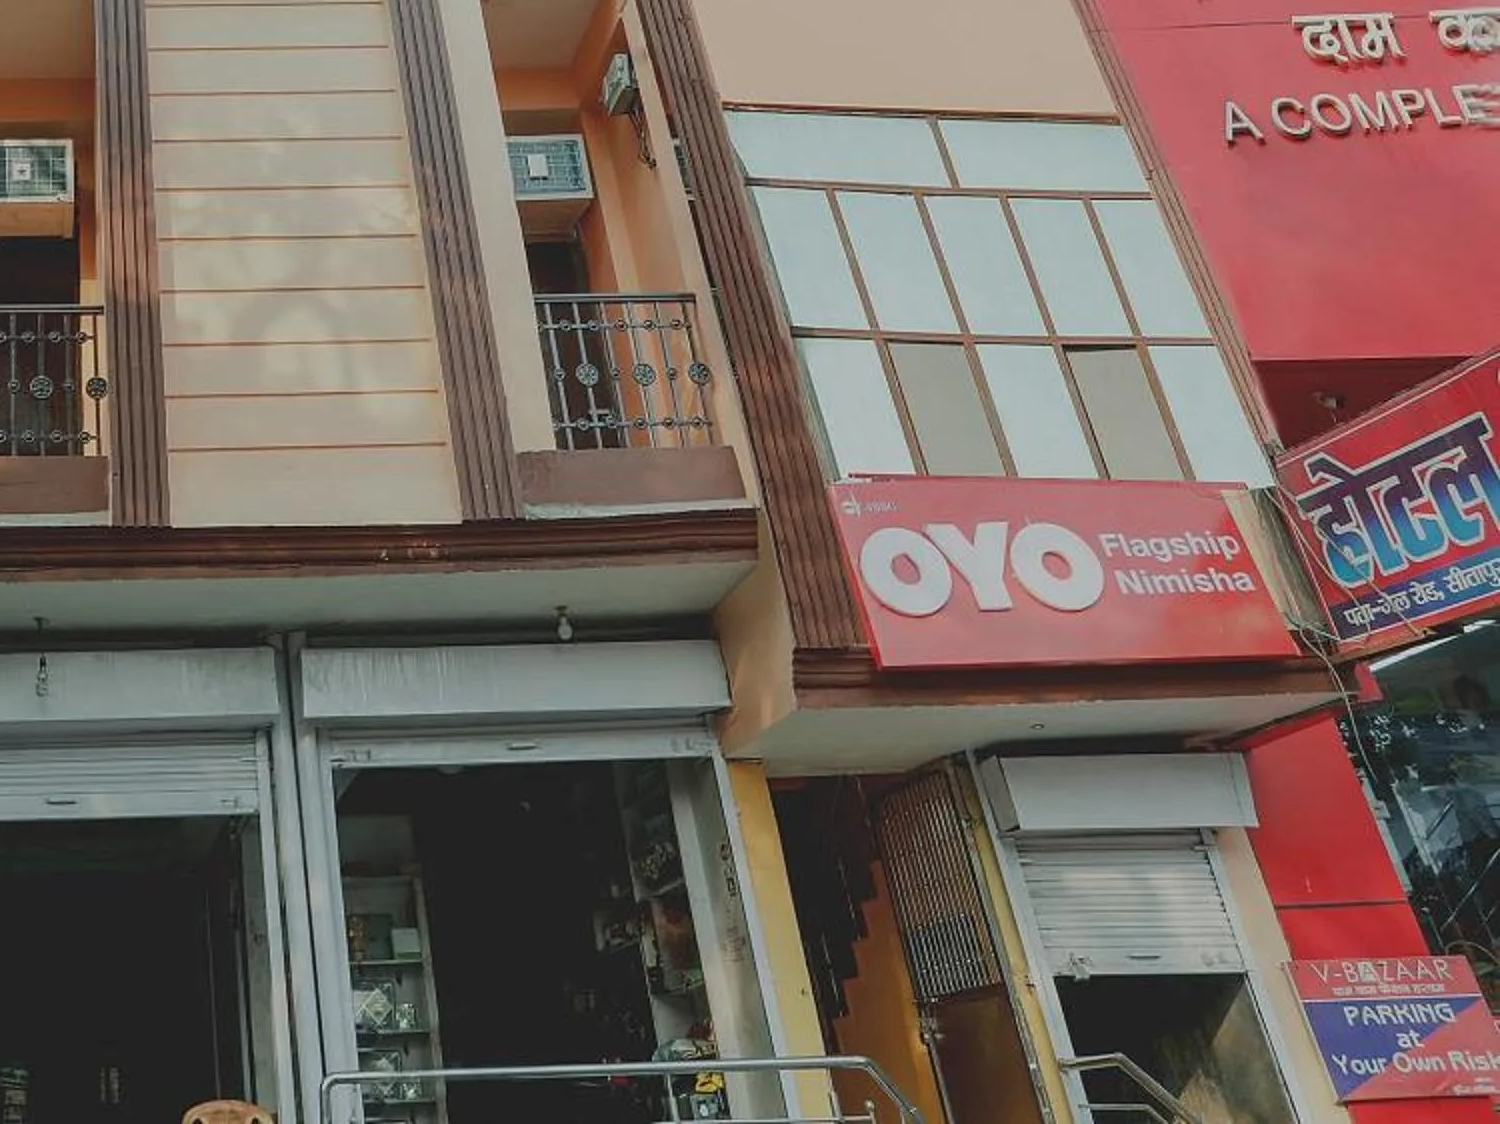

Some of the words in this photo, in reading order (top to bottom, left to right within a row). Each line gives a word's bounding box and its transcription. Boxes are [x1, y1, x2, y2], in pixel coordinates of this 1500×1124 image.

[1291, 11, 1408, 65] दाम
[1223, 100, 1265, 145] A
[1099, 530, 1241, 563] Flagship
[859, 521, 1105, 617] OYO
[1113, 569, 1257, 595] Nimisha
[1310, 959, 1454, 984] V-BAZAAR
[1343, 1003, 1457, 1026] PARKING
[1396, 1029, 1425, 1048] at
[1331, 1053, 1390, 1076] Your
[1393, 1052, 1447, 1072] Own
[1447, 1050, 1500, 1072] Risk
